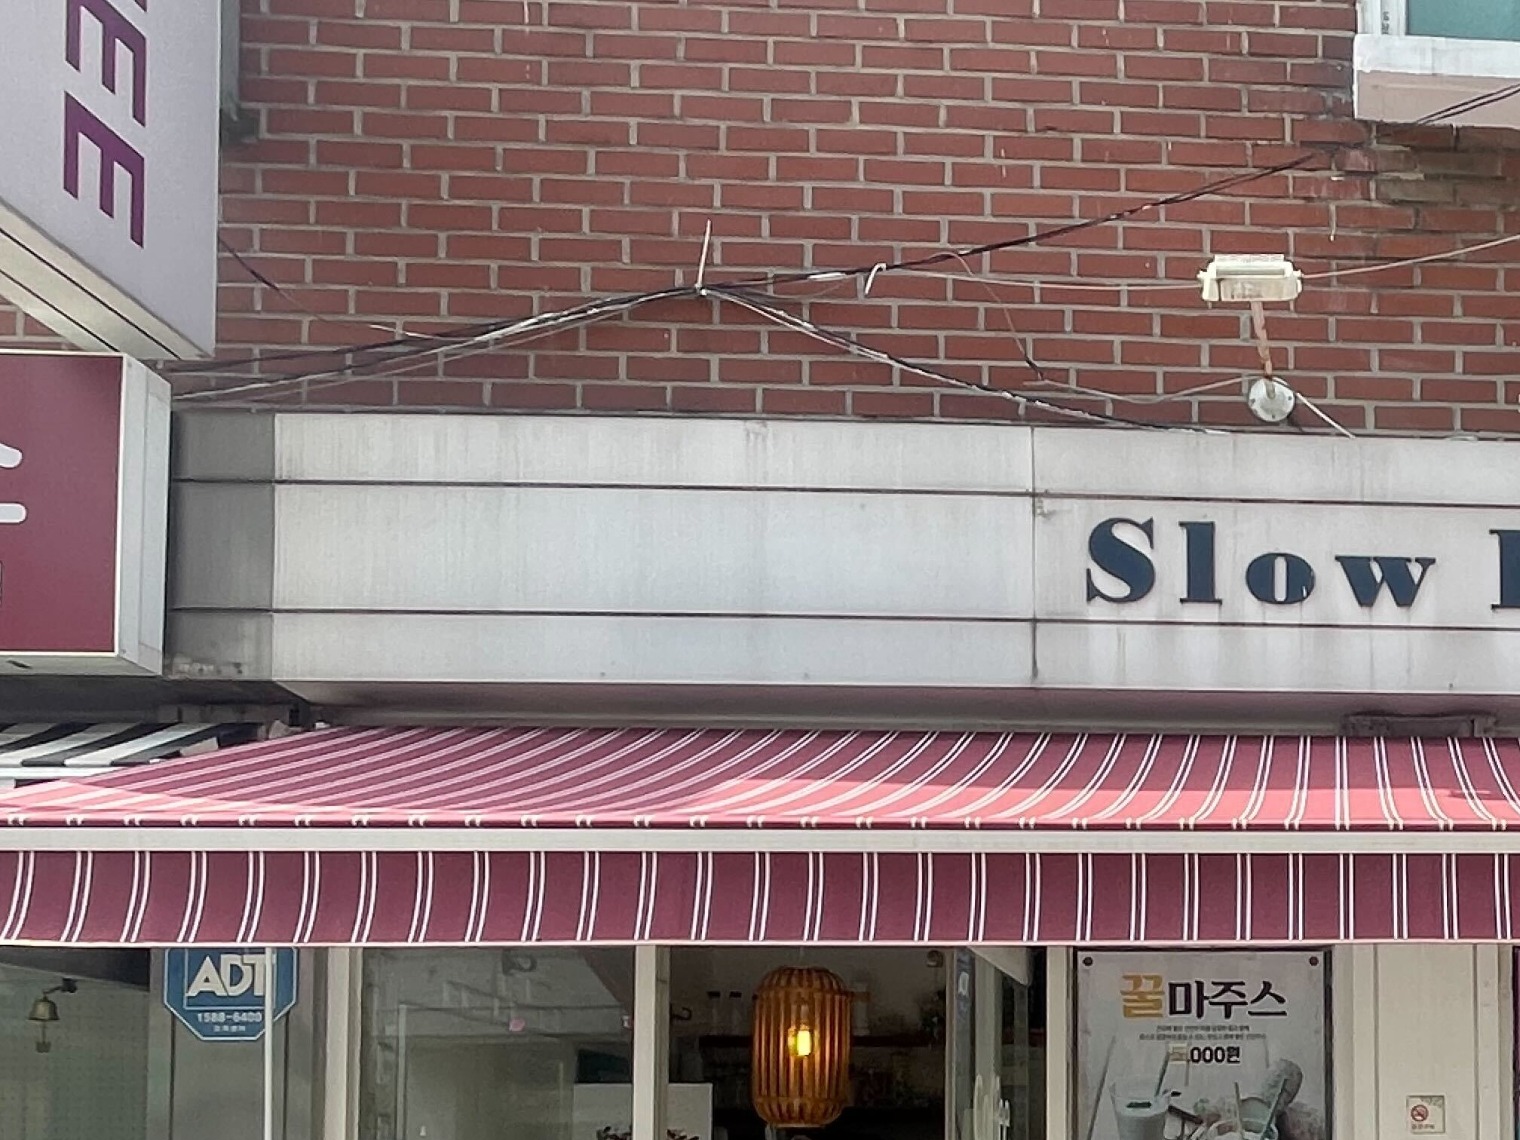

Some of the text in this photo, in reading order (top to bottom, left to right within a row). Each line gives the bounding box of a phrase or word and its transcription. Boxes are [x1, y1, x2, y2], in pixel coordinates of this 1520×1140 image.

[64, 0, 147, 248] EE
[1086, 517, 1436, 609] Slow
[185, 953, 276, 997] ADT
[1120, 974, 1288, 1019] 꿀마주스
[1182, 1046, 1241, 1064] ,000원
